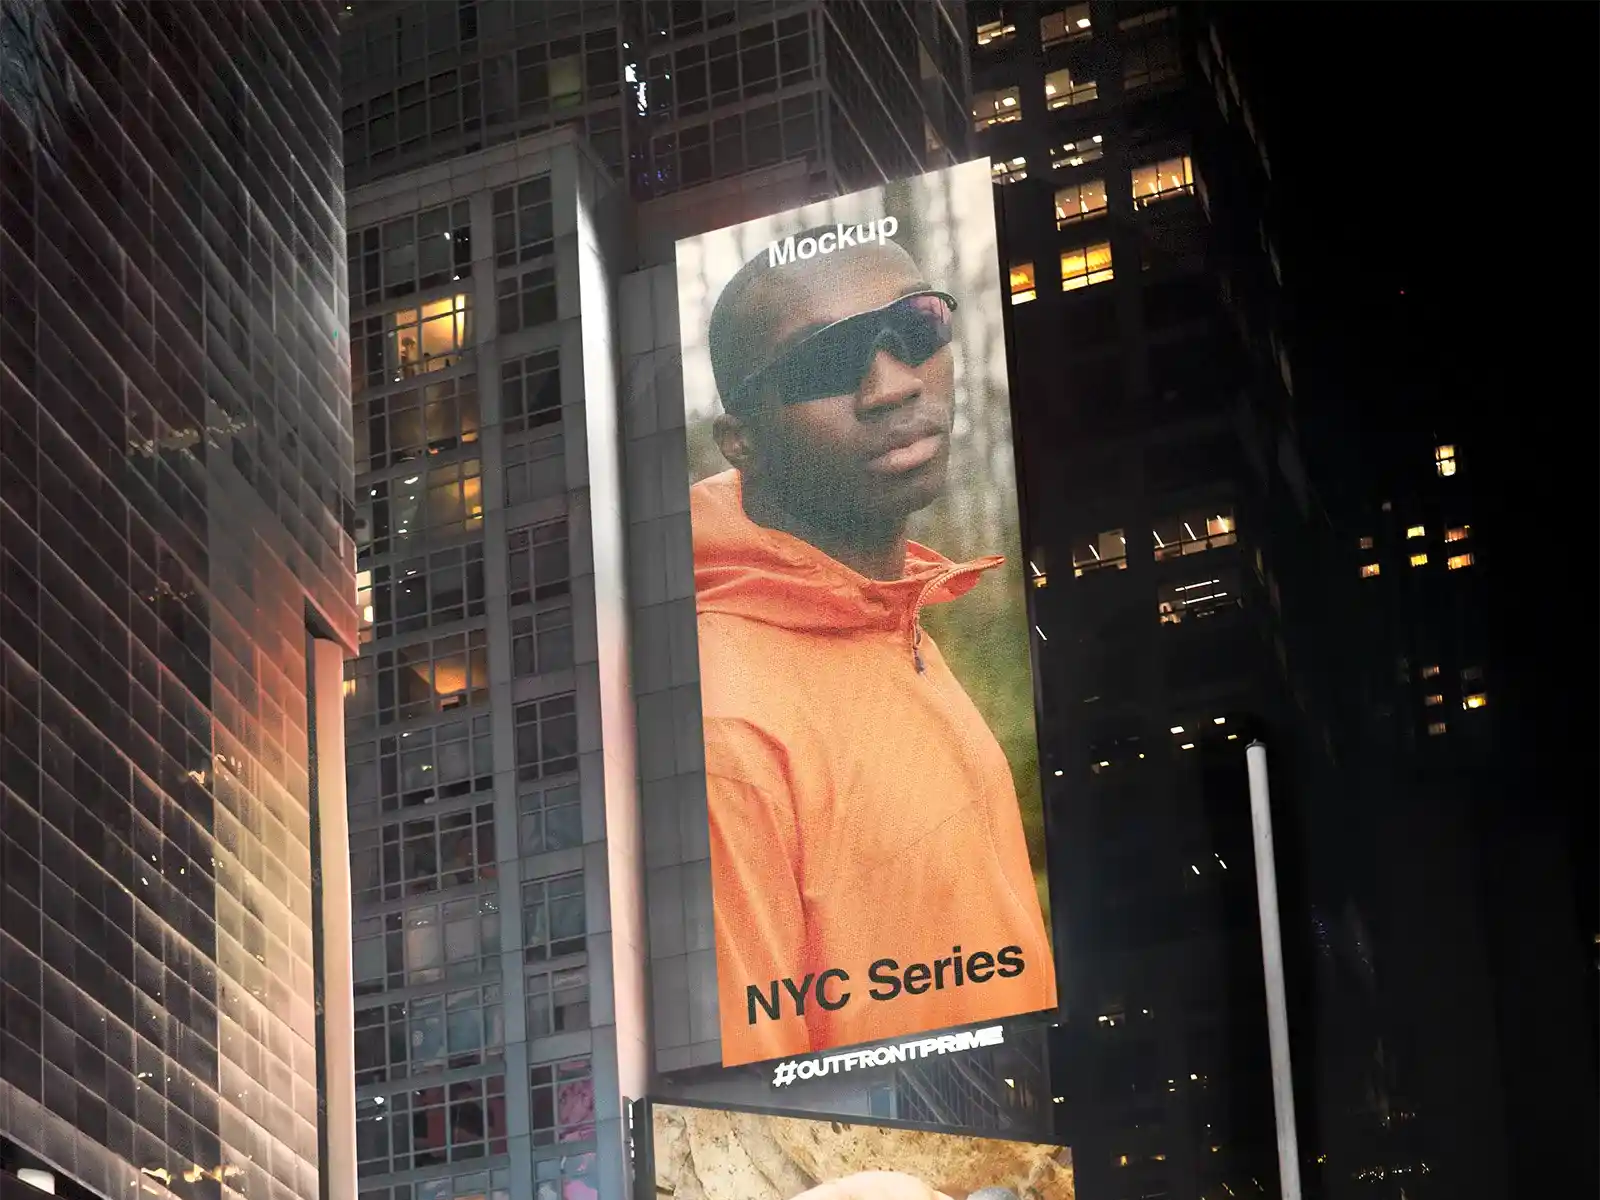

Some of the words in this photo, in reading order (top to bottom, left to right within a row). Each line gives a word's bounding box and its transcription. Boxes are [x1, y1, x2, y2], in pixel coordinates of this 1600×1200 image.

[768, 215, 898, 268] Mockup
[746, 968, 851, 1025] NYC
[868, 945, 1026, 1001] Series
[772, 1025, 1005, 1087] #OUTFRONTPRIME
